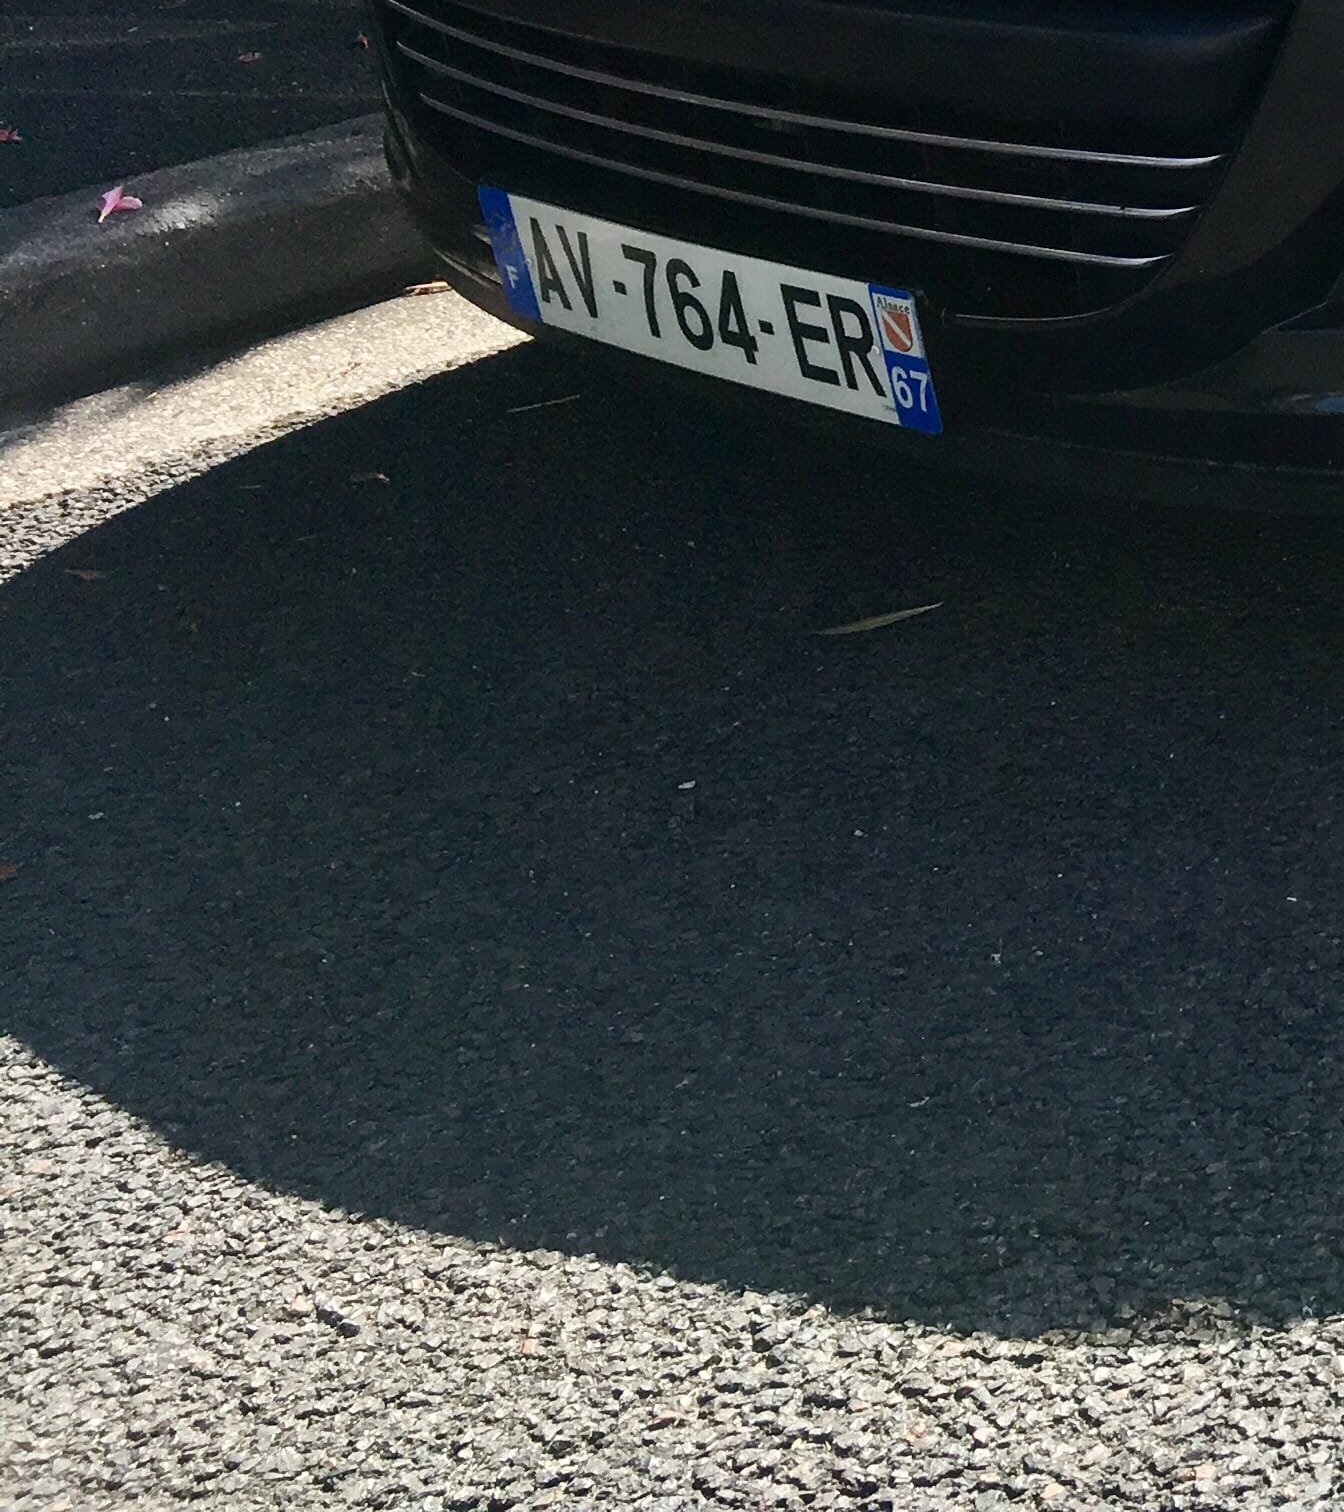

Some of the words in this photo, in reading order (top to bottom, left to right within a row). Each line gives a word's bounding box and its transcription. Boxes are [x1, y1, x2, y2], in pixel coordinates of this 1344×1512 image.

[505, 264, 518, 289] F
[529, 217, 887, 398] AV-764-ER
[891, 366, 928, 412] 67
